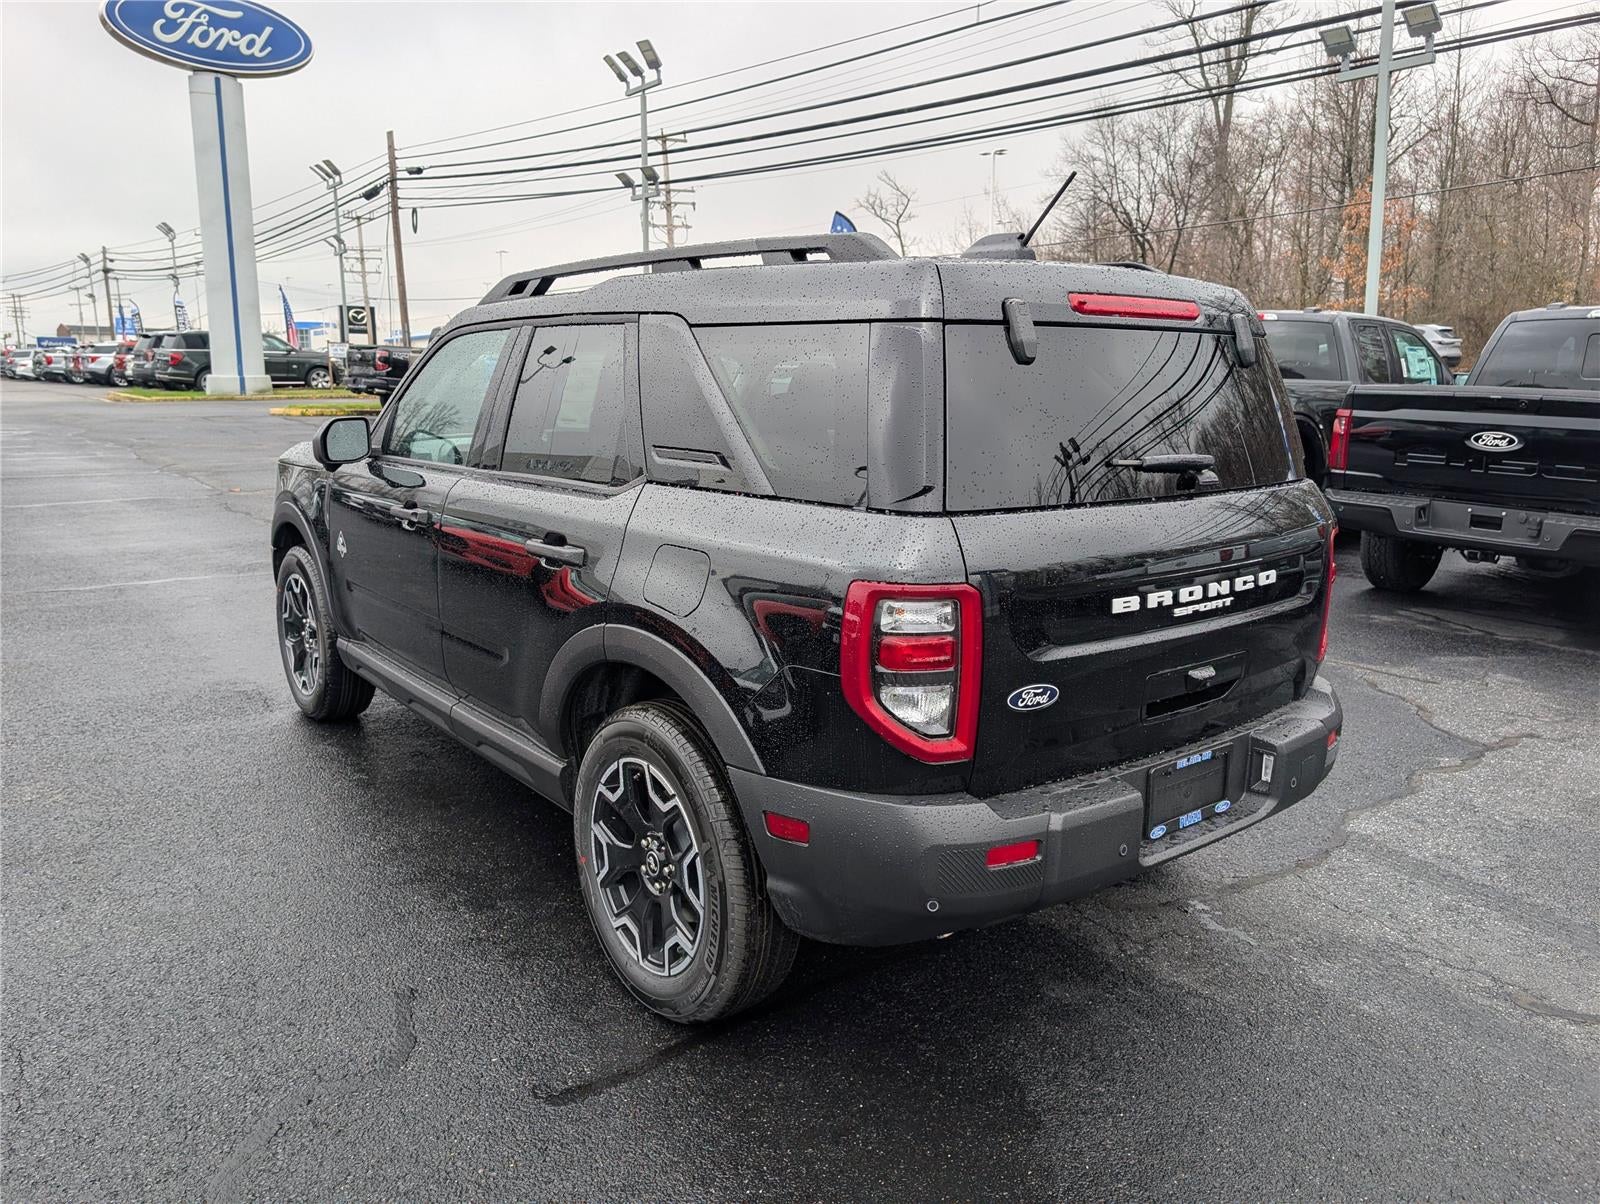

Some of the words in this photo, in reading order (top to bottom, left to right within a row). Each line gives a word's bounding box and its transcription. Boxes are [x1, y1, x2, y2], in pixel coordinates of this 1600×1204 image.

[153, 0, 273, 58] Ford
[1478, 433, 1509, 448] Ford
[1111, 569, 1277, 614] BRONCO
[1173, 597, 1235, 617] SPORT
[1017, 687, 1051, 708] Ford
[704, 884, 720, 973] MICHELIN
